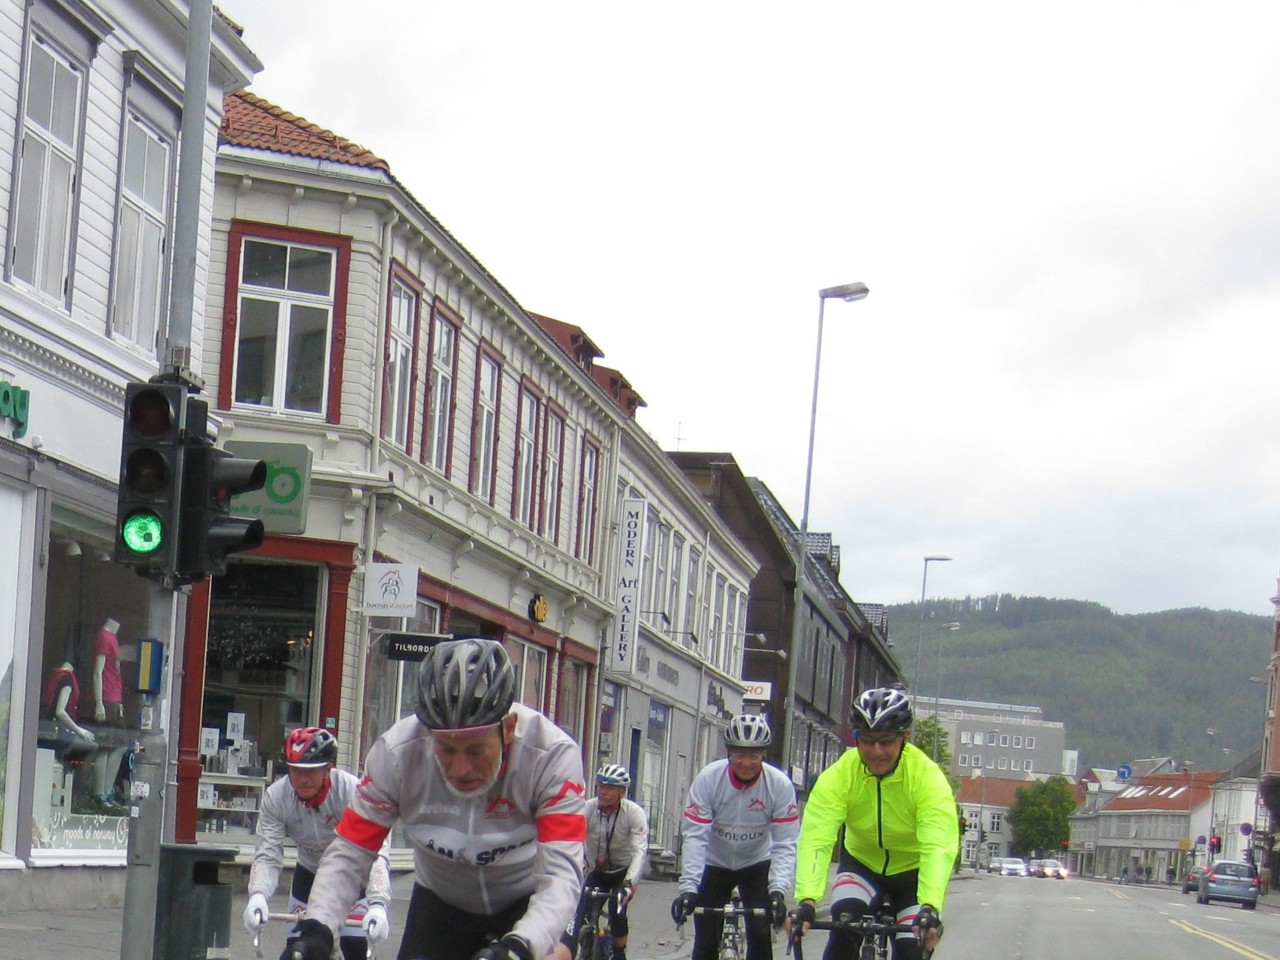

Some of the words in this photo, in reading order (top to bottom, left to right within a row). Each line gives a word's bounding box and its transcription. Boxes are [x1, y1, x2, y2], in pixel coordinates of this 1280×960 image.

[624, 510, 639, 568] MODERN
[618, 576, 638, 588] Art
[618, 595, 632, 662] GALLERY
